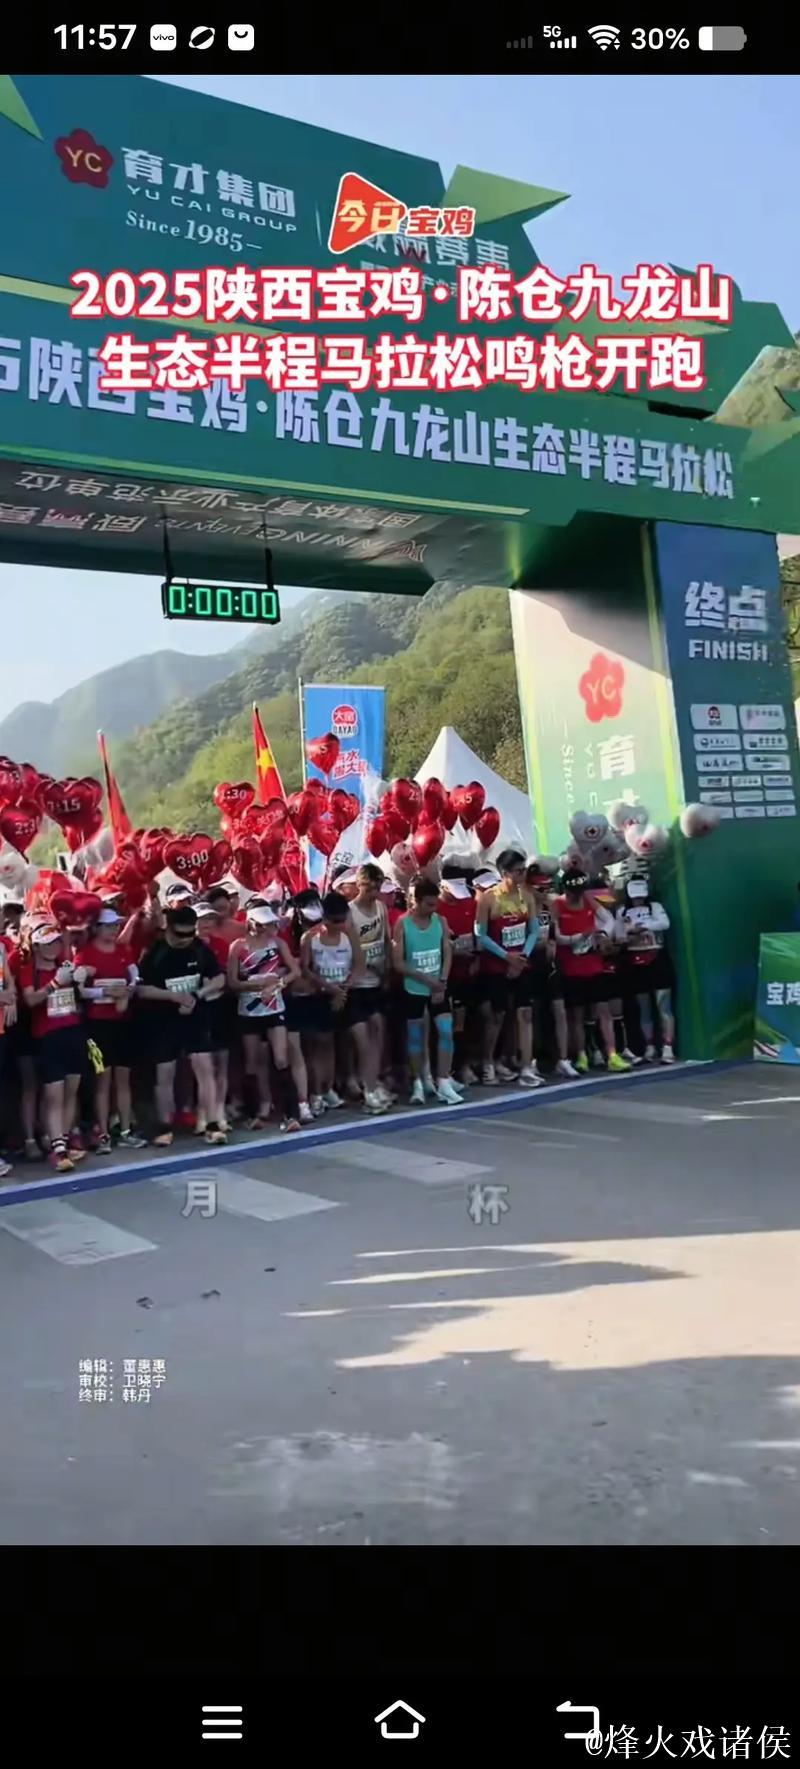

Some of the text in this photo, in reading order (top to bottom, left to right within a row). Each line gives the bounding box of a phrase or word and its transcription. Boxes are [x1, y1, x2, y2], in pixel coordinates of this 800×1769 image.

[64, 146, 103, 173] YC
[121, 147, 296, 218] 育才集团
[127, 184, 298, 233] YU CAI GROUP
[126, 210, 182, 238] Since
[169, 585, 277, 618] 0:00:00
[684, 581, 768, 632] 终点
[688, 639, 768, 661] FINISH
[587, 675, 617, 703] YC
[176, 849, 209, 870] 3:00
